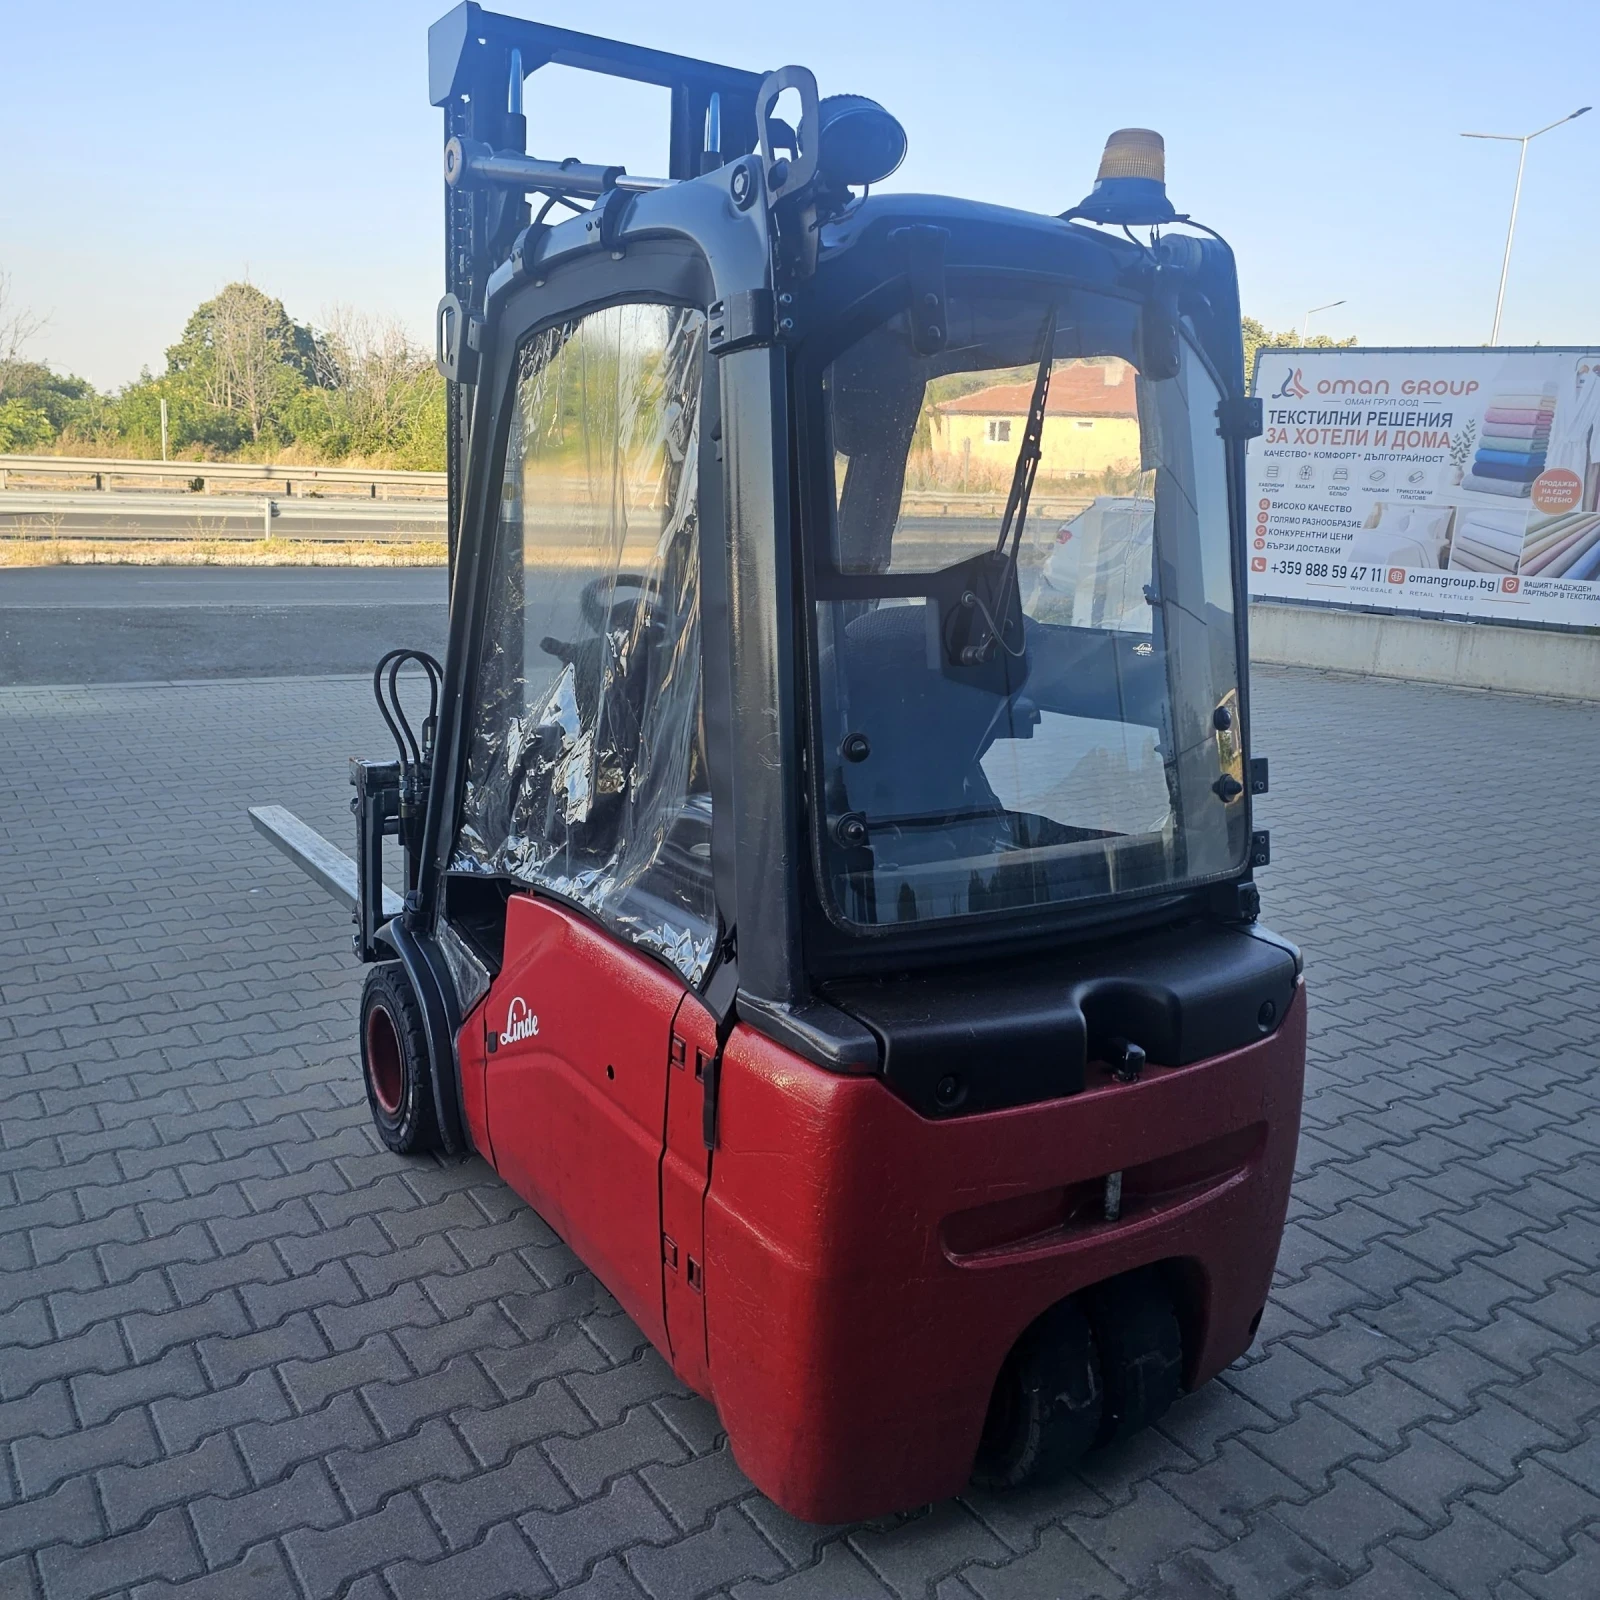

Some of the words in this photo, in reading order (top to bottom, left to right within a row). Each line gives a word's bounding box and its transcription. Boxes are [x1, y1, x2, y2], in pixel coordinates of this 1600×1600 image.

[1401, 379, 1479, 396] GROUP
[1344, 398, 1371, 406] ОМАН
[1373, 398, 1397, 407] ГРУП
[1398, 398, 1419, 408] ООД
[1268, 410, 1362, 426] ТЕКСТИЛНИ
[1366, 411, 1453, 428] РЕШЕНИЯ
[1265, 427, 1288, 444] ЗА
[1293, 428, 1369, 446] ХОТЕЛИ
[1373, 430, 1388, 447] И
[1390, 430, 1451, 451] ДОМА
[1363, 452, 1445, 463] ДЪЛГОТРАЙНОСТ
[1539, 480, 1578, 488] ПРОДАЖБИ
[1543, 496, 1573, 504] ДРЕБНО
[1271, 501, 1306, 511] ВИСОКО
[1307, 503, 1352, 513] КАЧЕСТВО
[1269, 515, 1301, 525] ГОЛЯМО
[1301, 517, 1362, 529] РАЗНООБРАЗИЕ
[1268, 528, 1328, 540] КОНКУРЕНТНИ
[1329, 532, 1354, 541] ЦЕНИ
[1266, 541, 1295, 551] БЪРЗИ
[1295, 544, 1341, 554] ДОСТАВКИ
[1270, 560, 1302, 575] +359
[1305, 562, 1328, 578] 888
[1331, 564, 1347, 579] 59
[1350, 566, 1367, 581] 47
[1371, 567, 1382, 583] 11
[1408, 574, 1495, 592] omangroup.bg
[1523, 581, 1553, 589] ВАШИЯТ
[1553, 583, 1592, 593] НАДЕЖДЕН
[1350, 585, 1393, 594] WHOLESALE
[1409, 590, 1434, 598] RETAIL
[1439, 593, 1474, 601] TEXTILES
[1522, 588, 1559, 598] ПАРТНЬОР
[500, 996, 539, 1046] Linde
